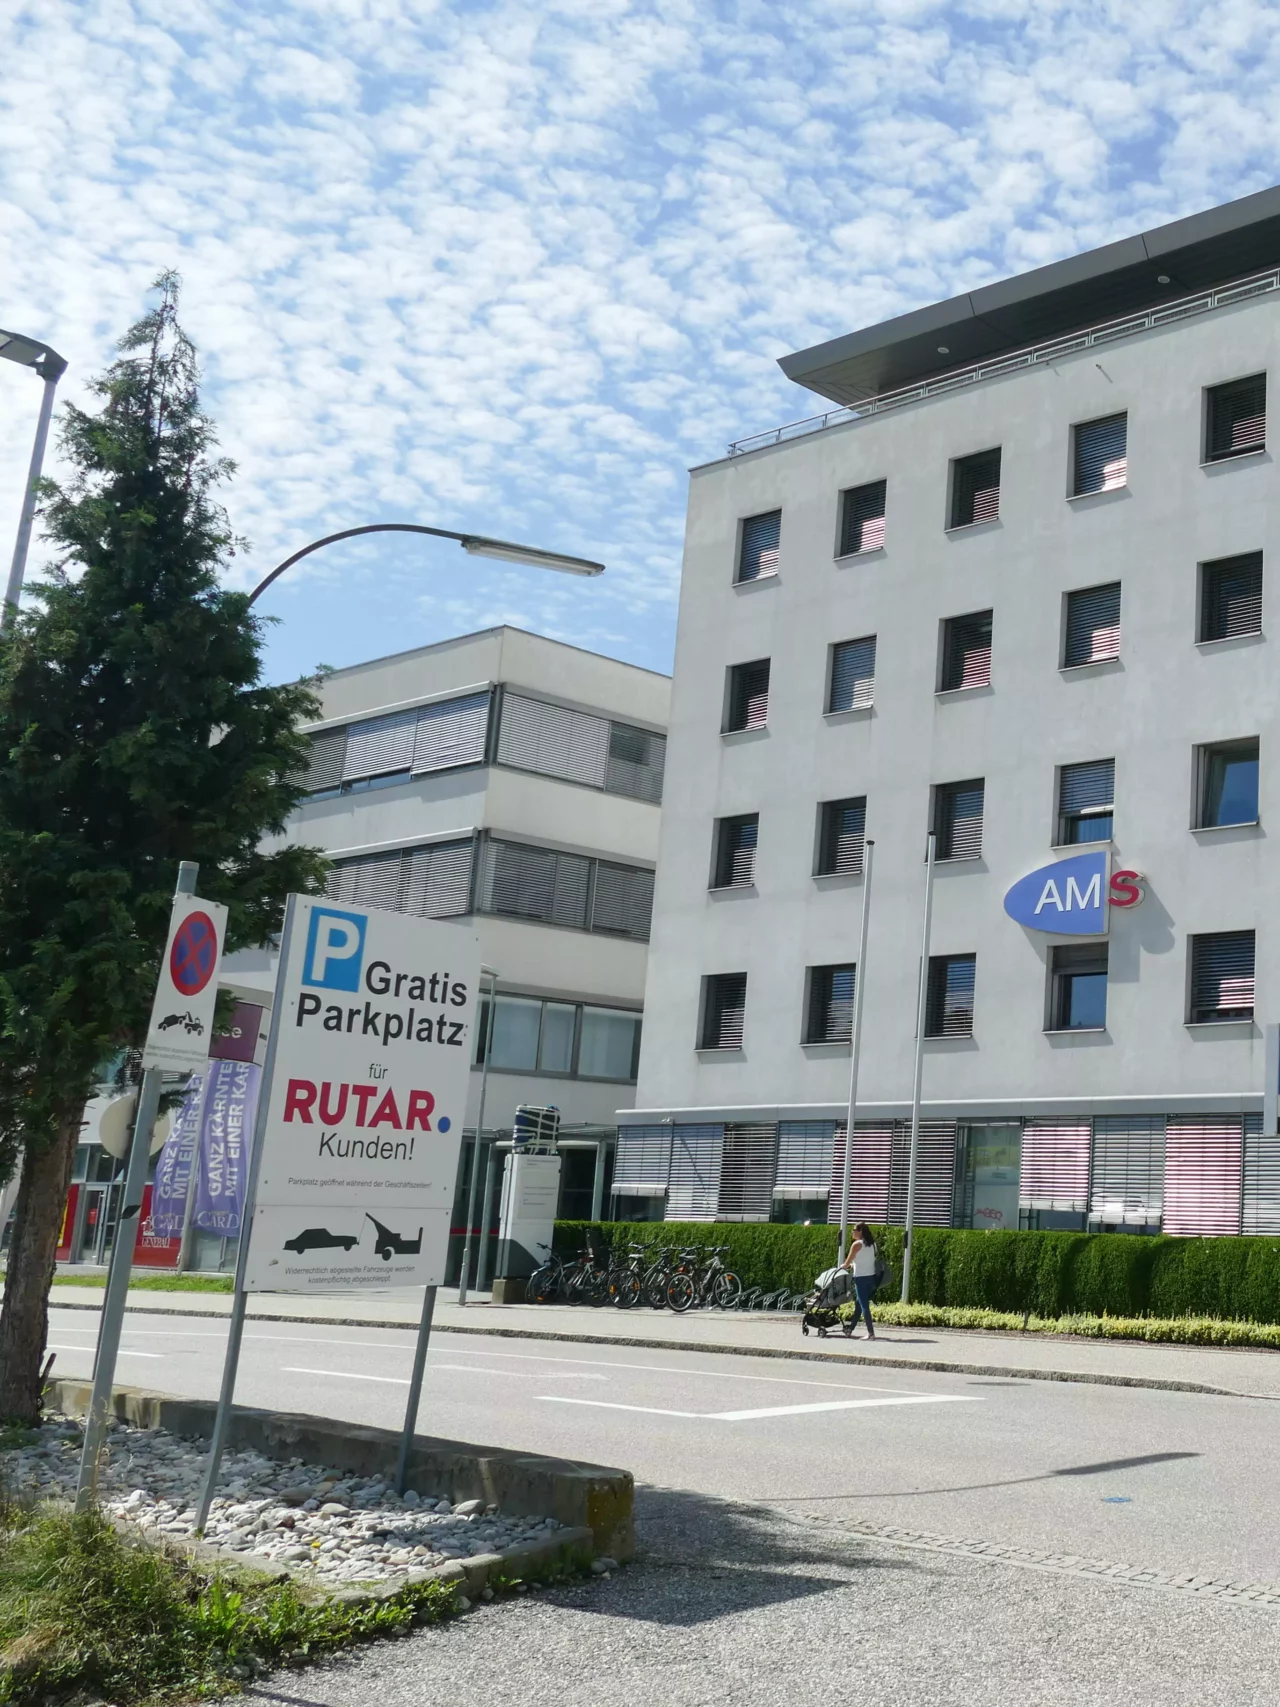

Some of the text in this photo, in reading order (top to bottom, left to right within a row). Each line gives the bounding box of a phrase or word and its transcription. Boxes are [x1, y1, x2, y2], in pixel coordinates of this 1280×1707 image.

[1034, 870, 1141, 915] AMS
[311, 915, 360, 982] P
[365, 961, 467, 1007] Gratis
[296, 992, 465, 1046] Parkplatz
[368, 1063, 388, 1080] für
[179, 1108, 200, 1162] EINER
[227, 1104, 244, 1158] EINER
[318, 1132, 415, 1161] Kunden!
[160, 1147, 178, 1199] GANZ
[172, 1168, 188, 1199] MIT
[209, 1143, 225, 1197] GANZ
[225, 1166, 239, 1196] MIT
[288, 1177, 318, 1187] Parkplatz
[319, 1179, 345, 1187] geöffnet
[345, 1180, 372, 1188] während
[373, 1180, 384, 1188] der
[363, 1265, 394, 1274] Fahrzeuge
[395, 1265, 415, 1273] werden
